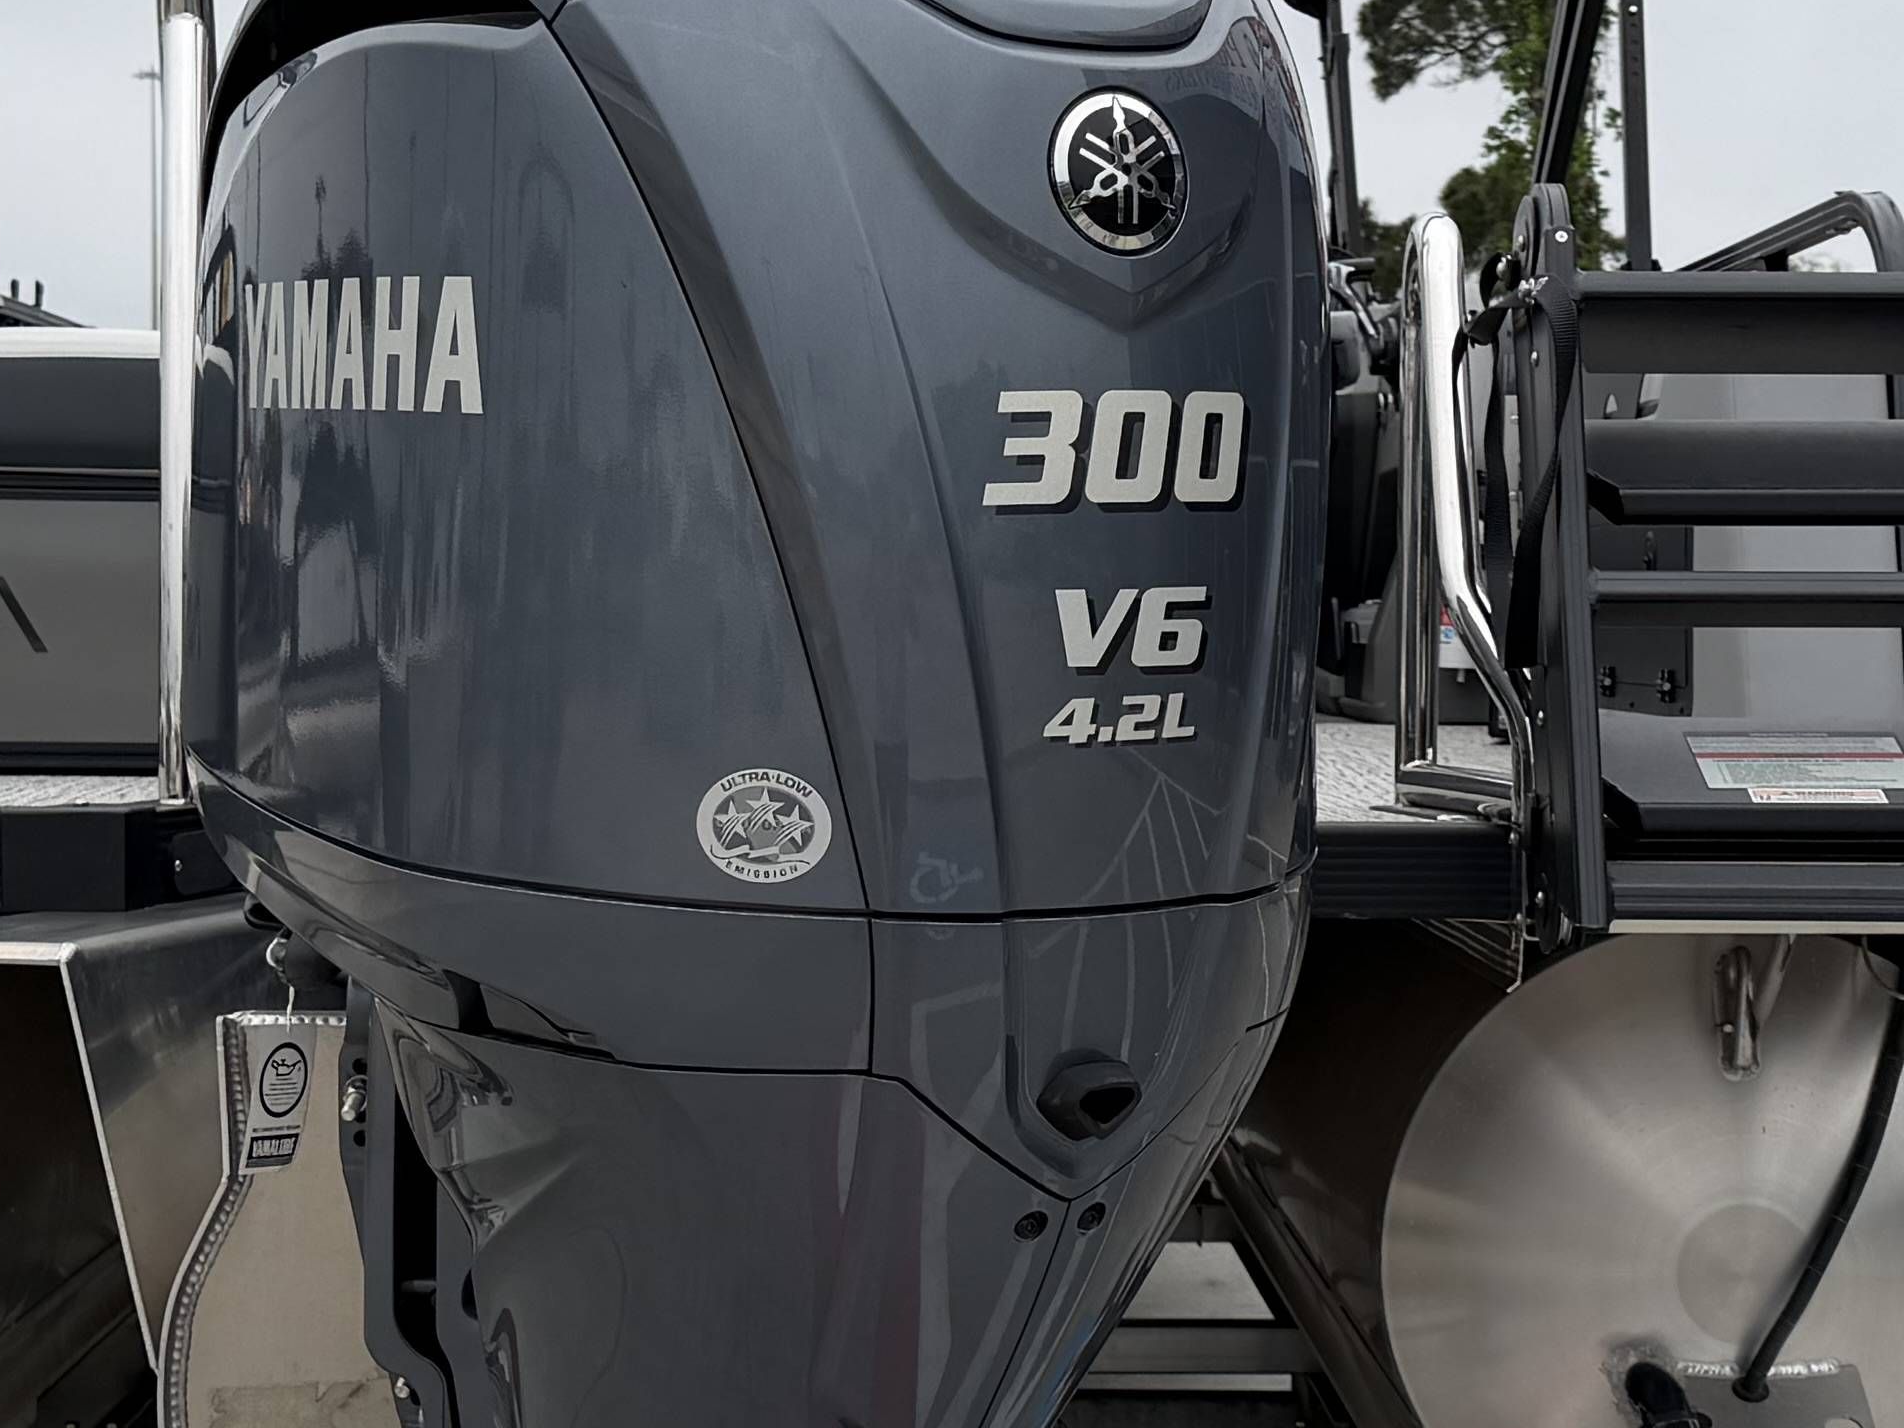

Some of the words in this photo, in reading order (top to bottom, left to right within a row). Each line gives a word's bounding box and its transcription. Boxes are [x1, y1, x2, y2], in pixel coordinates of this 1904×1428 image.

[244, 274, 485, 416] YAMAHA
[982, 389, 1246, 512] 300
[1053, 583, 1212, 674] V6
[1041, 693, 1199, 748] 4.2L
[725, 859, 798, 879] EMISSION
